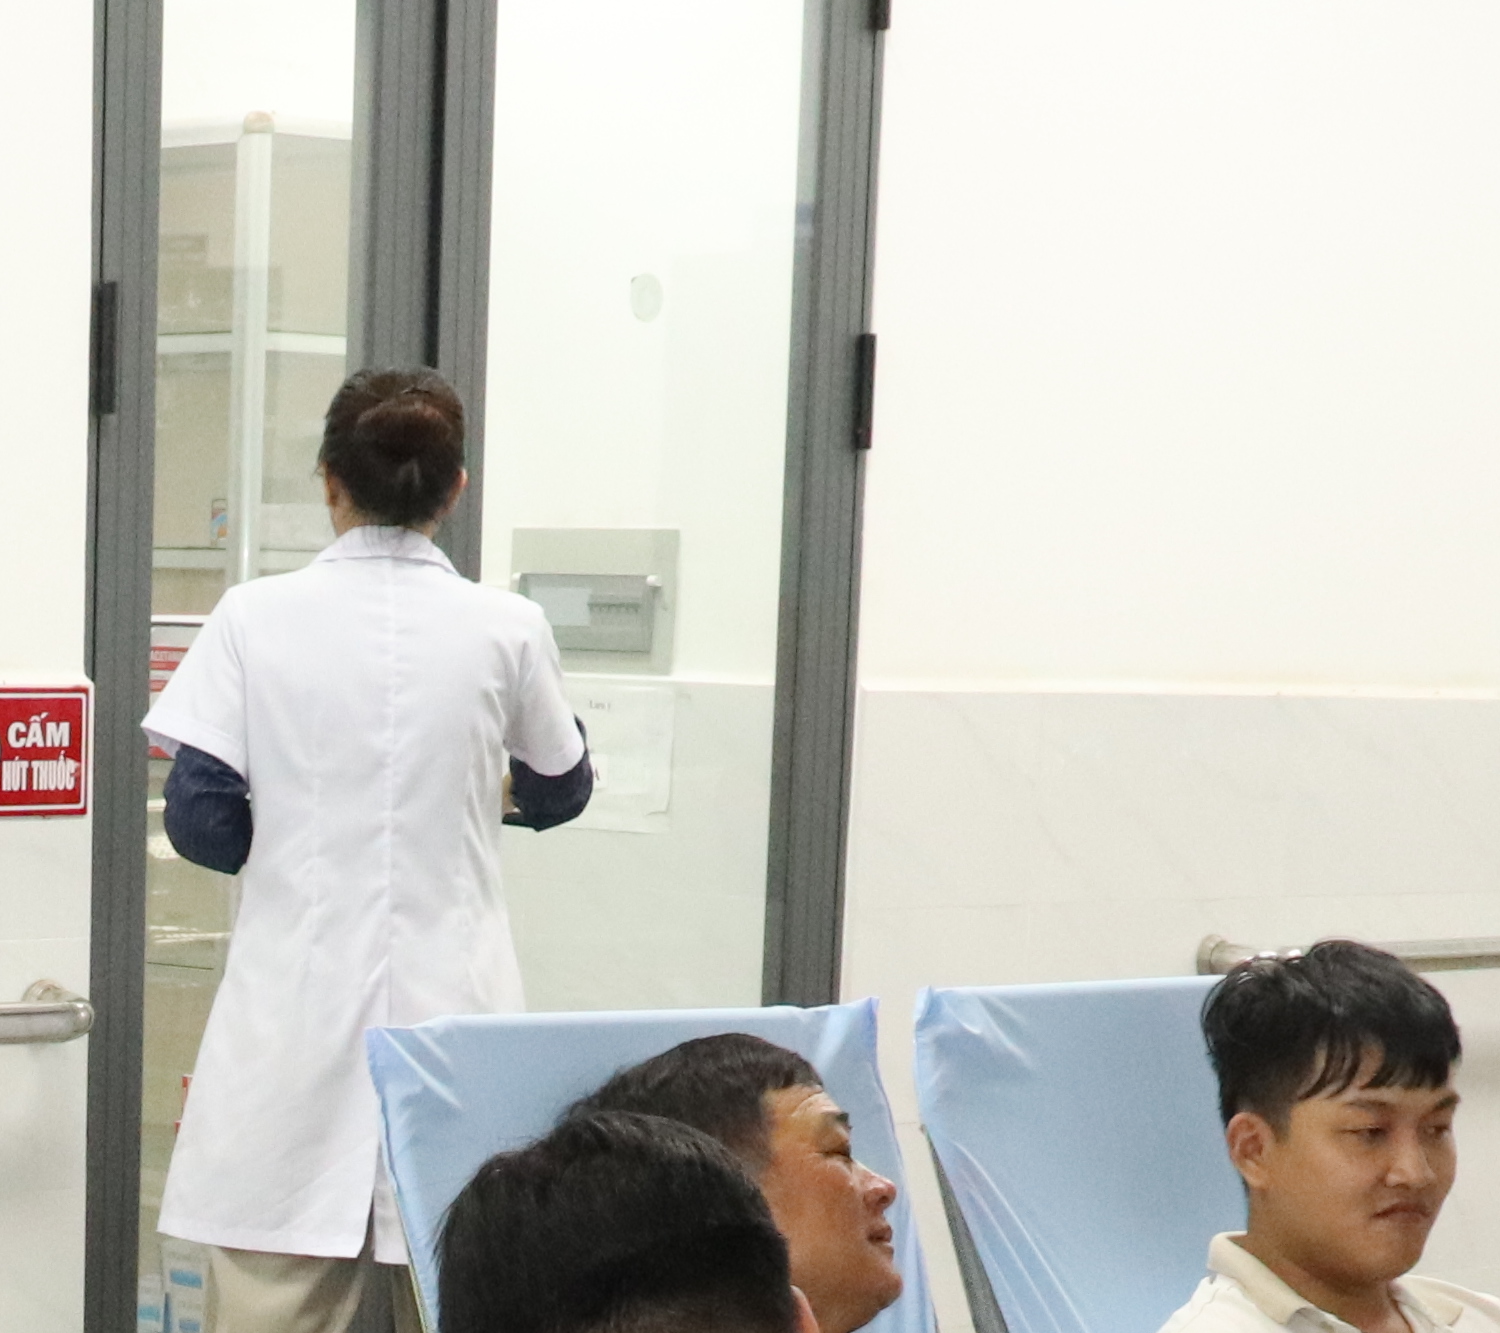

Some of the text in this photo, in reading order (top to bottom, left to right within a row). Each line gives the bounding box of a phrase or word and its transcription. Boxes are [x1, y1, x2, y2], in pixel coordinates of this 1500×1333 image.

[7, 711, 71, 748] CẤM
[1, 750, 78, 792] HÚT THUỐC
